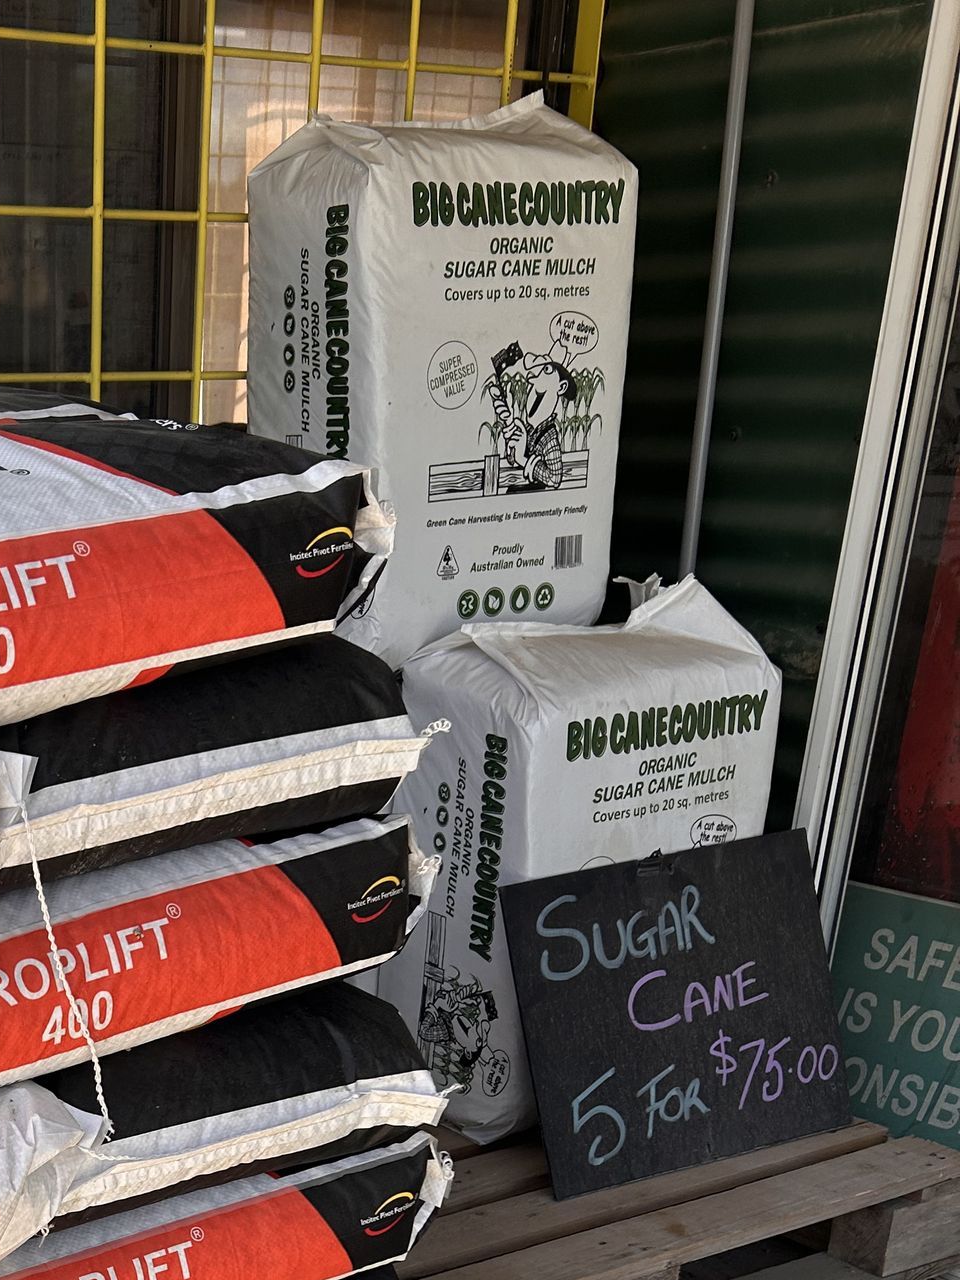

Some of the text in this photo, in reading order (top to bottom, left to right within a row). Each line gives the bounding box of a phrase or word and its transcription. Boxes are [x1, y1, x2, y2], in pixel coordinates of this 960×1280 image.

[490, 236, 554, 255] ORGANIC
[443, 257, 596, 279] SUGAR CANE MULCH
[444, 285, 590, 303] Covers up to 20 sq. metres
[300, 247, 311, 433] SUGAR CANE MULCH
[311, 301, 321, 381] ORGANIC
[429, 362, 476, 391] COMPRESSED
[439, 354, 462, 374] SUPER
[443, 382, 466, 399] VALUE
[426, 519, 447, 528] Green
[448, 517, 466, 526] Cane
[467, 513, 504, 524] Harvesting
[512, 507, 563, 520] Environmentally
[563, 505, 589, 516] Friendly
[470, 560, 514, 573] Australian
[516, 556, 544, 568] Owned
[492, 543, 525, 556] Proudly
[638, 752, 698, 776] ORGANIC
[593, 764, 736, 804] SUGAR CANE MULCH
[593, 790, 729, 823] Covers up to 20 sq. metres
[445, 756, 467, 918] SUGAR CANE MULCH
[460, 807, 475, 877] ORGANIC
[536, 884, 716, 981] SUGAR
[627, 960, 769, 1031] CANE
[42, 990, 114, 1046] 400
[571, 1066, 626, 1166] 5
[709, 1028, 838, 1109] $75.00
